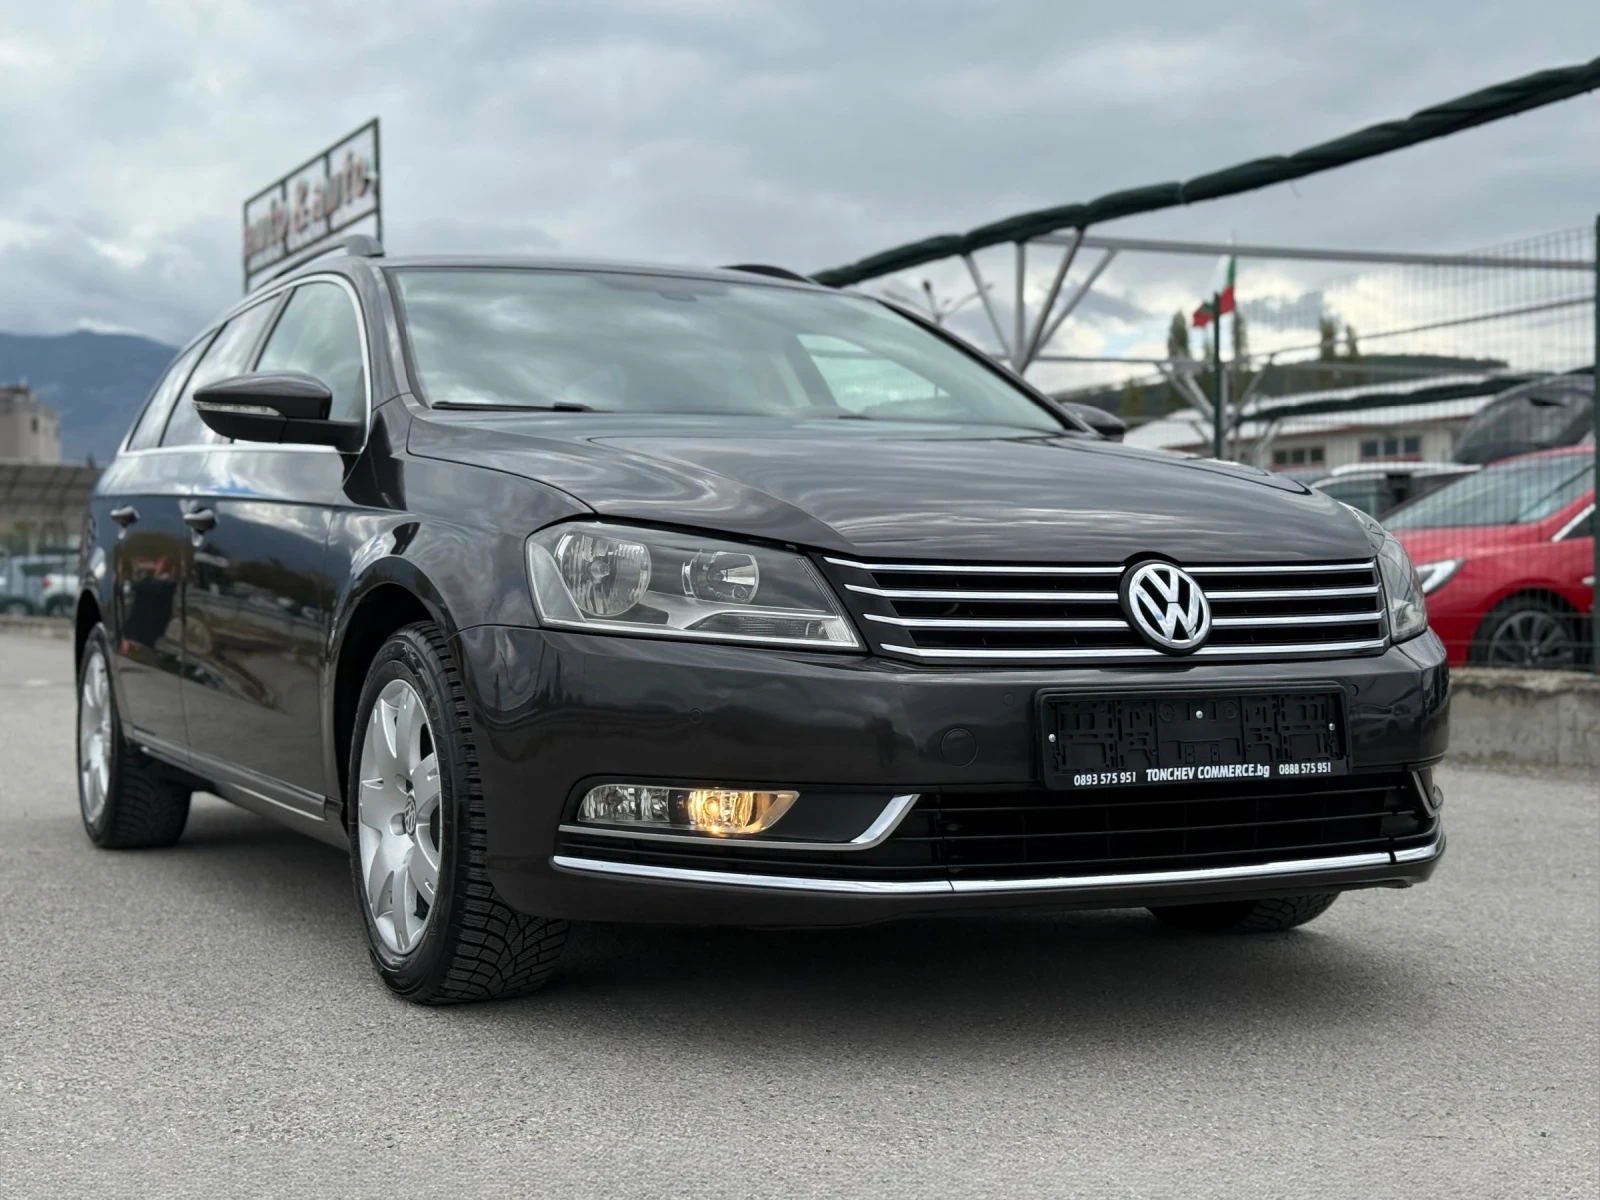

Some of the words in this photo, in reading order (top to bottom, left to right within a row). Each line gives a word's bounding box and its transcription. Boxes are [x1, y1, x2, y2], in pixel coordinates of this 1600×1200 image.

[1128, 562, 1211, 649] VW
[1073, 773, 1098, 787] 0893
[1100, 772, 1118, 785] 575
[1119, 771, 1136, 784] 951
[1146, 766, 1195, 782] TONCHEV
[1197, 763, 1270, 779] COMMERCE.bg
[1279, 763, 1300, 775] 0888
[1301, 762, 1316, 774] 575
[1317, 761, 1331, 773] 951
